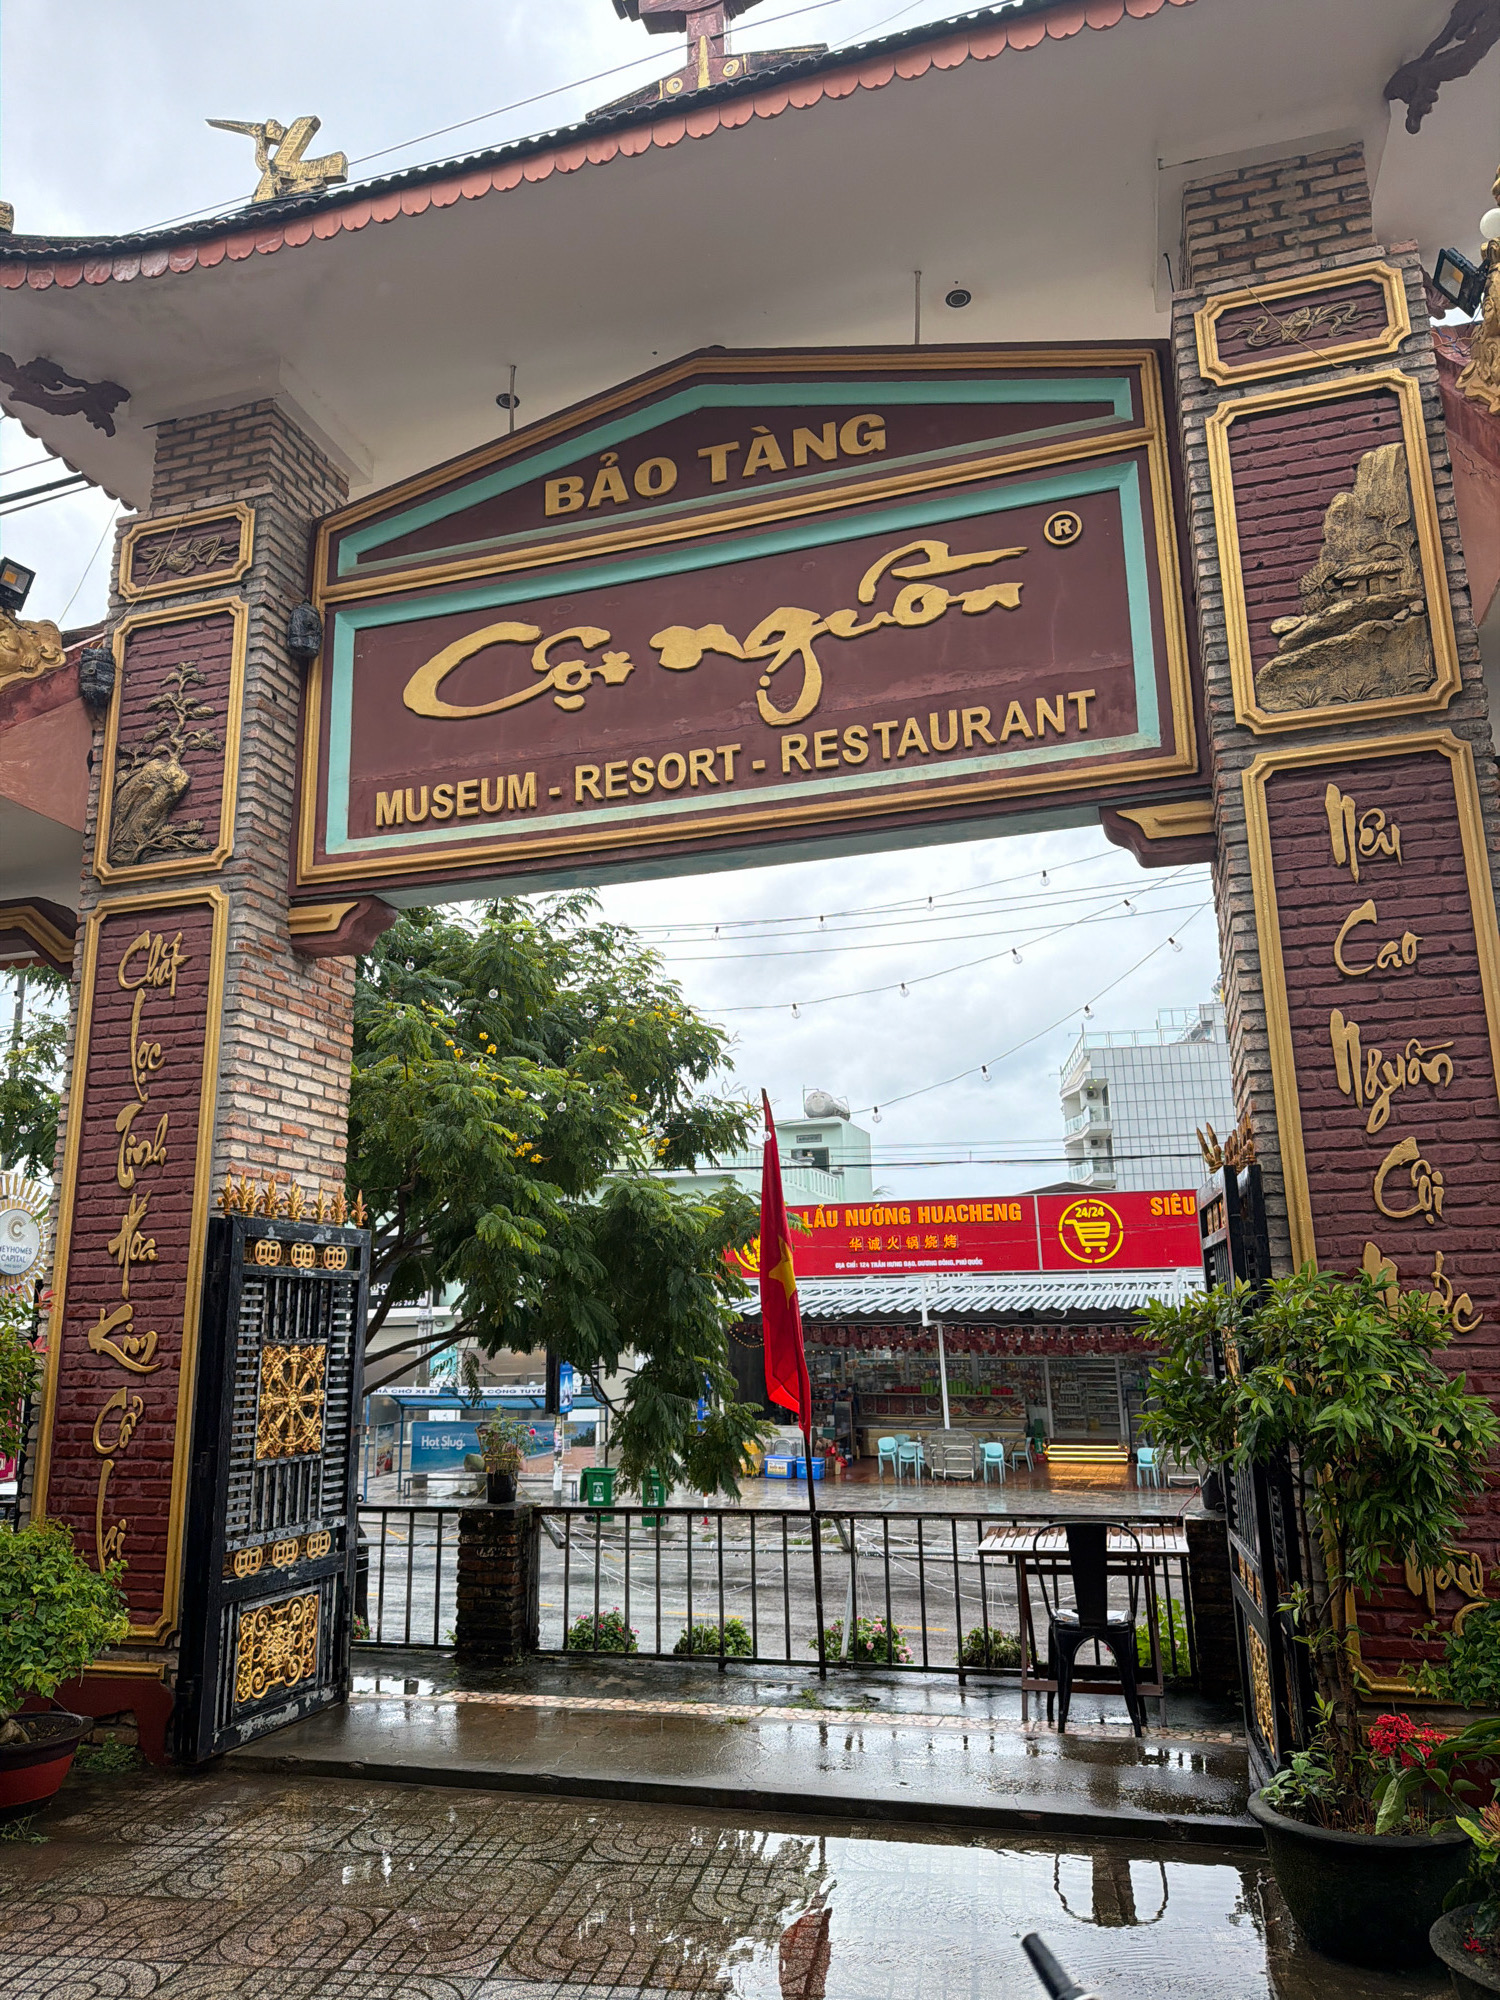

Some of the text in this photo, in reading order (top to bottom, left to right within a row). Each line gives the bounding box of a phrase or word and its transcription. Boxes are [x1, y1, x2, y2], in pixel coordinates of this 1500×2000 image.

[545, 413, 887, 516] BẢO TÀNG
[375, 771, 538, 827] MUSEUM
[575, 743, 742, 802] RESORT
[781, 688, 1097, 773] RESTAURANT
[1334, 899, 1424, 976] Cao
[116, 1103, 168, 1190] Tinh
[803, 1202, 1022, 1229] LẨU NƯỚNG HUACHENG
[1074, 1206, 1105, 1218] 24/24
[1150, 1193, 1196, 1216] SIÊU
[1, 1254, 26, 1263] CAPITAL
[88, 1304, 161, 1373] Kim
[421, 1435, 439, 1447] Hot
